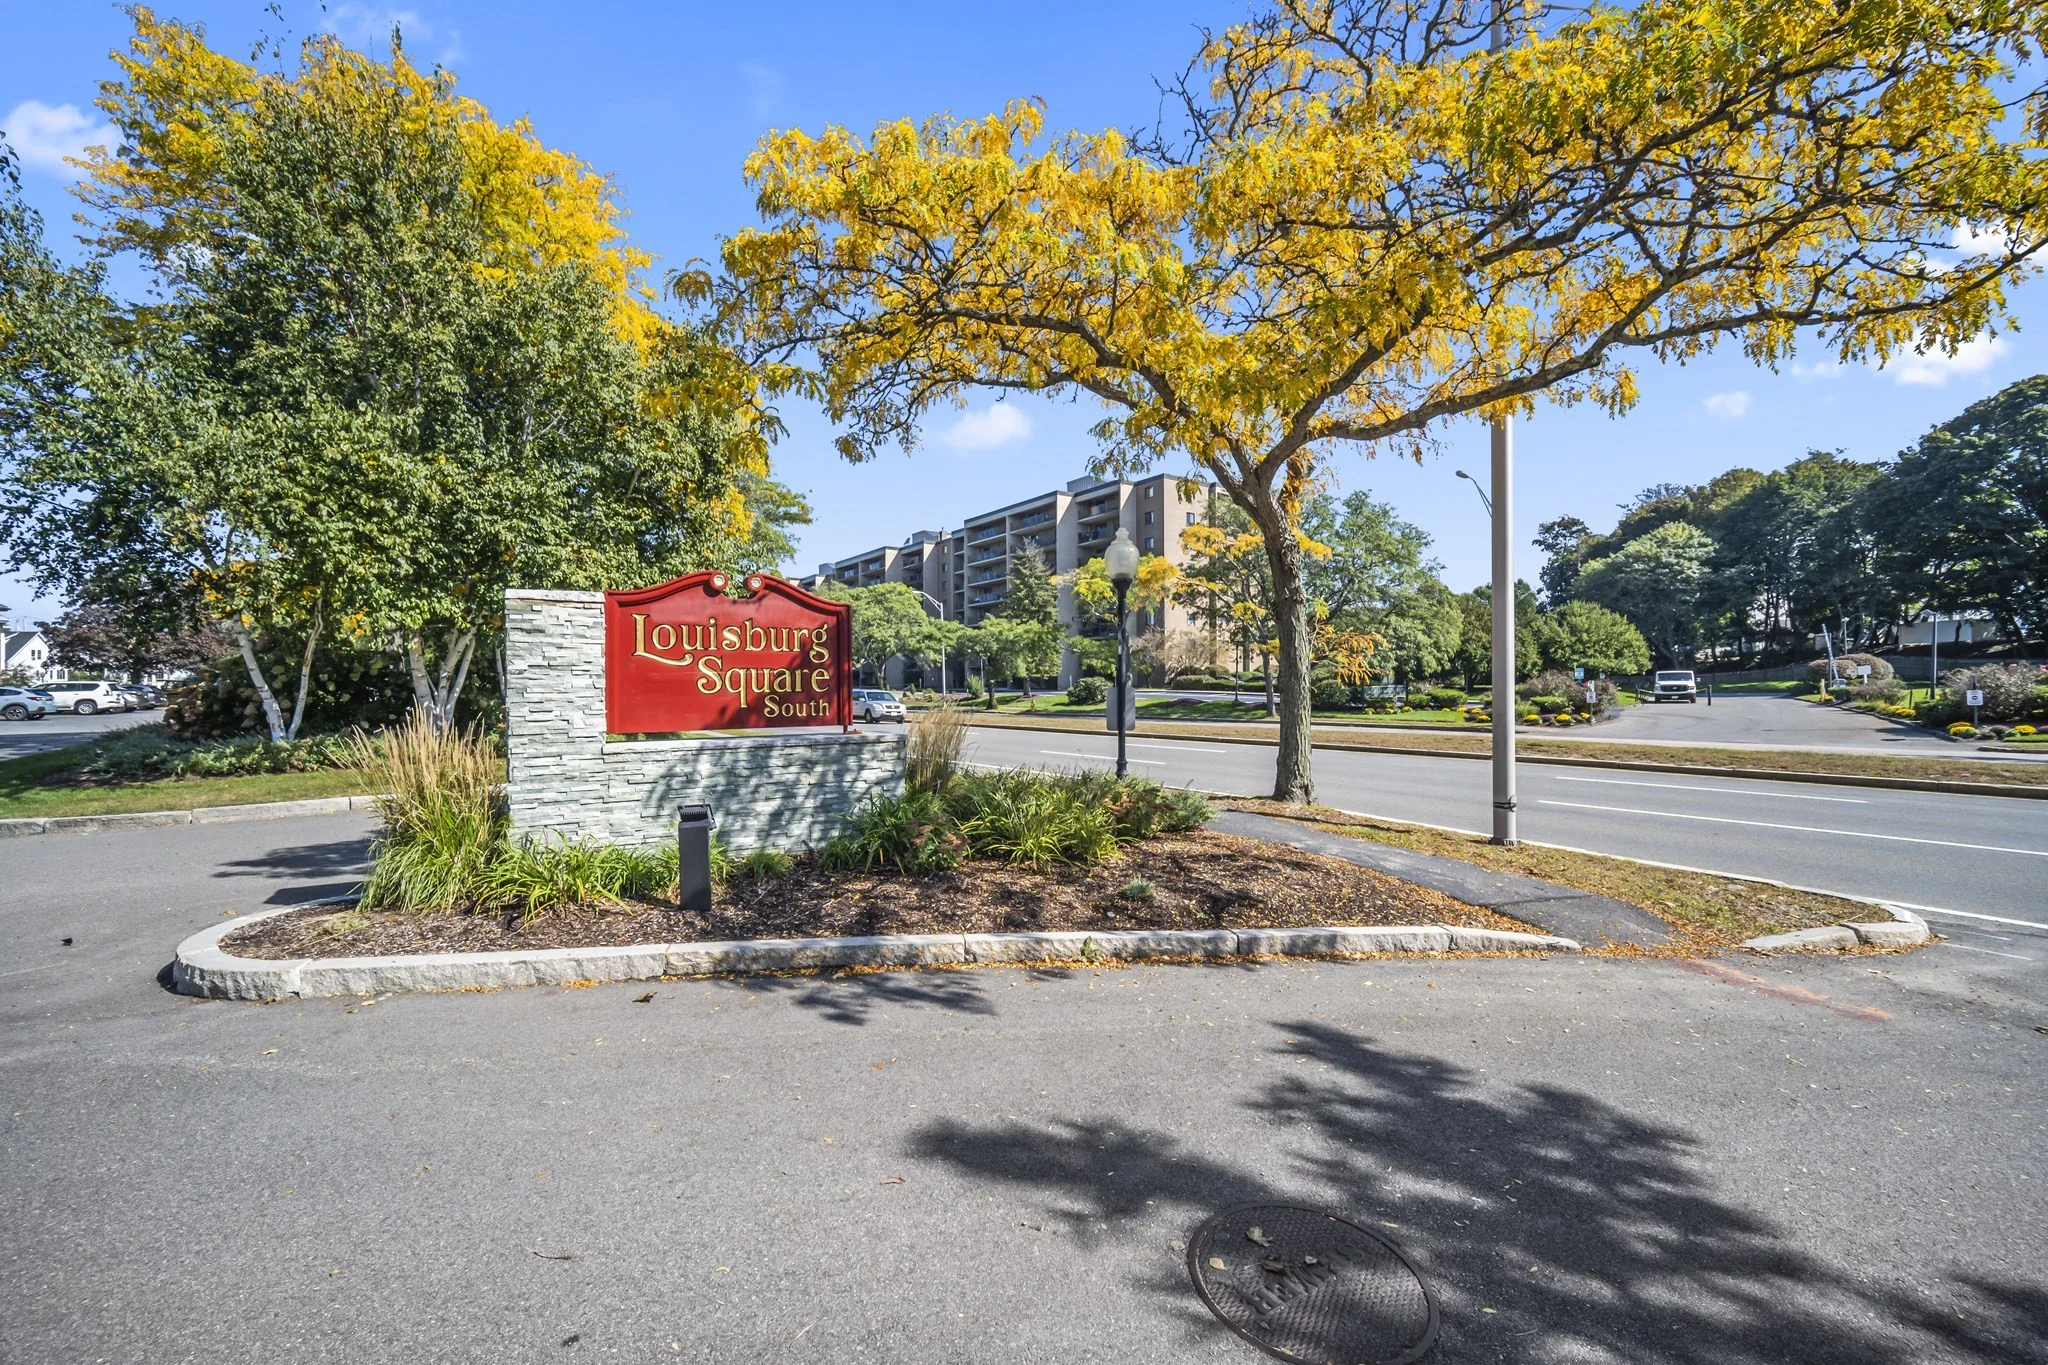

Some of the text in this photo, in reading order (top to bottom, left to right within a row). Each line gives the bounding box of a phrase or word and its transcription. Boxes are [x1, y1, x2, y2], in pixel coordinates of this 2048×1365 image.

[631, 613, 830, 666] Louisburg
[697, 655, 831, 708] Square
[764, 695, 831, 717] South
